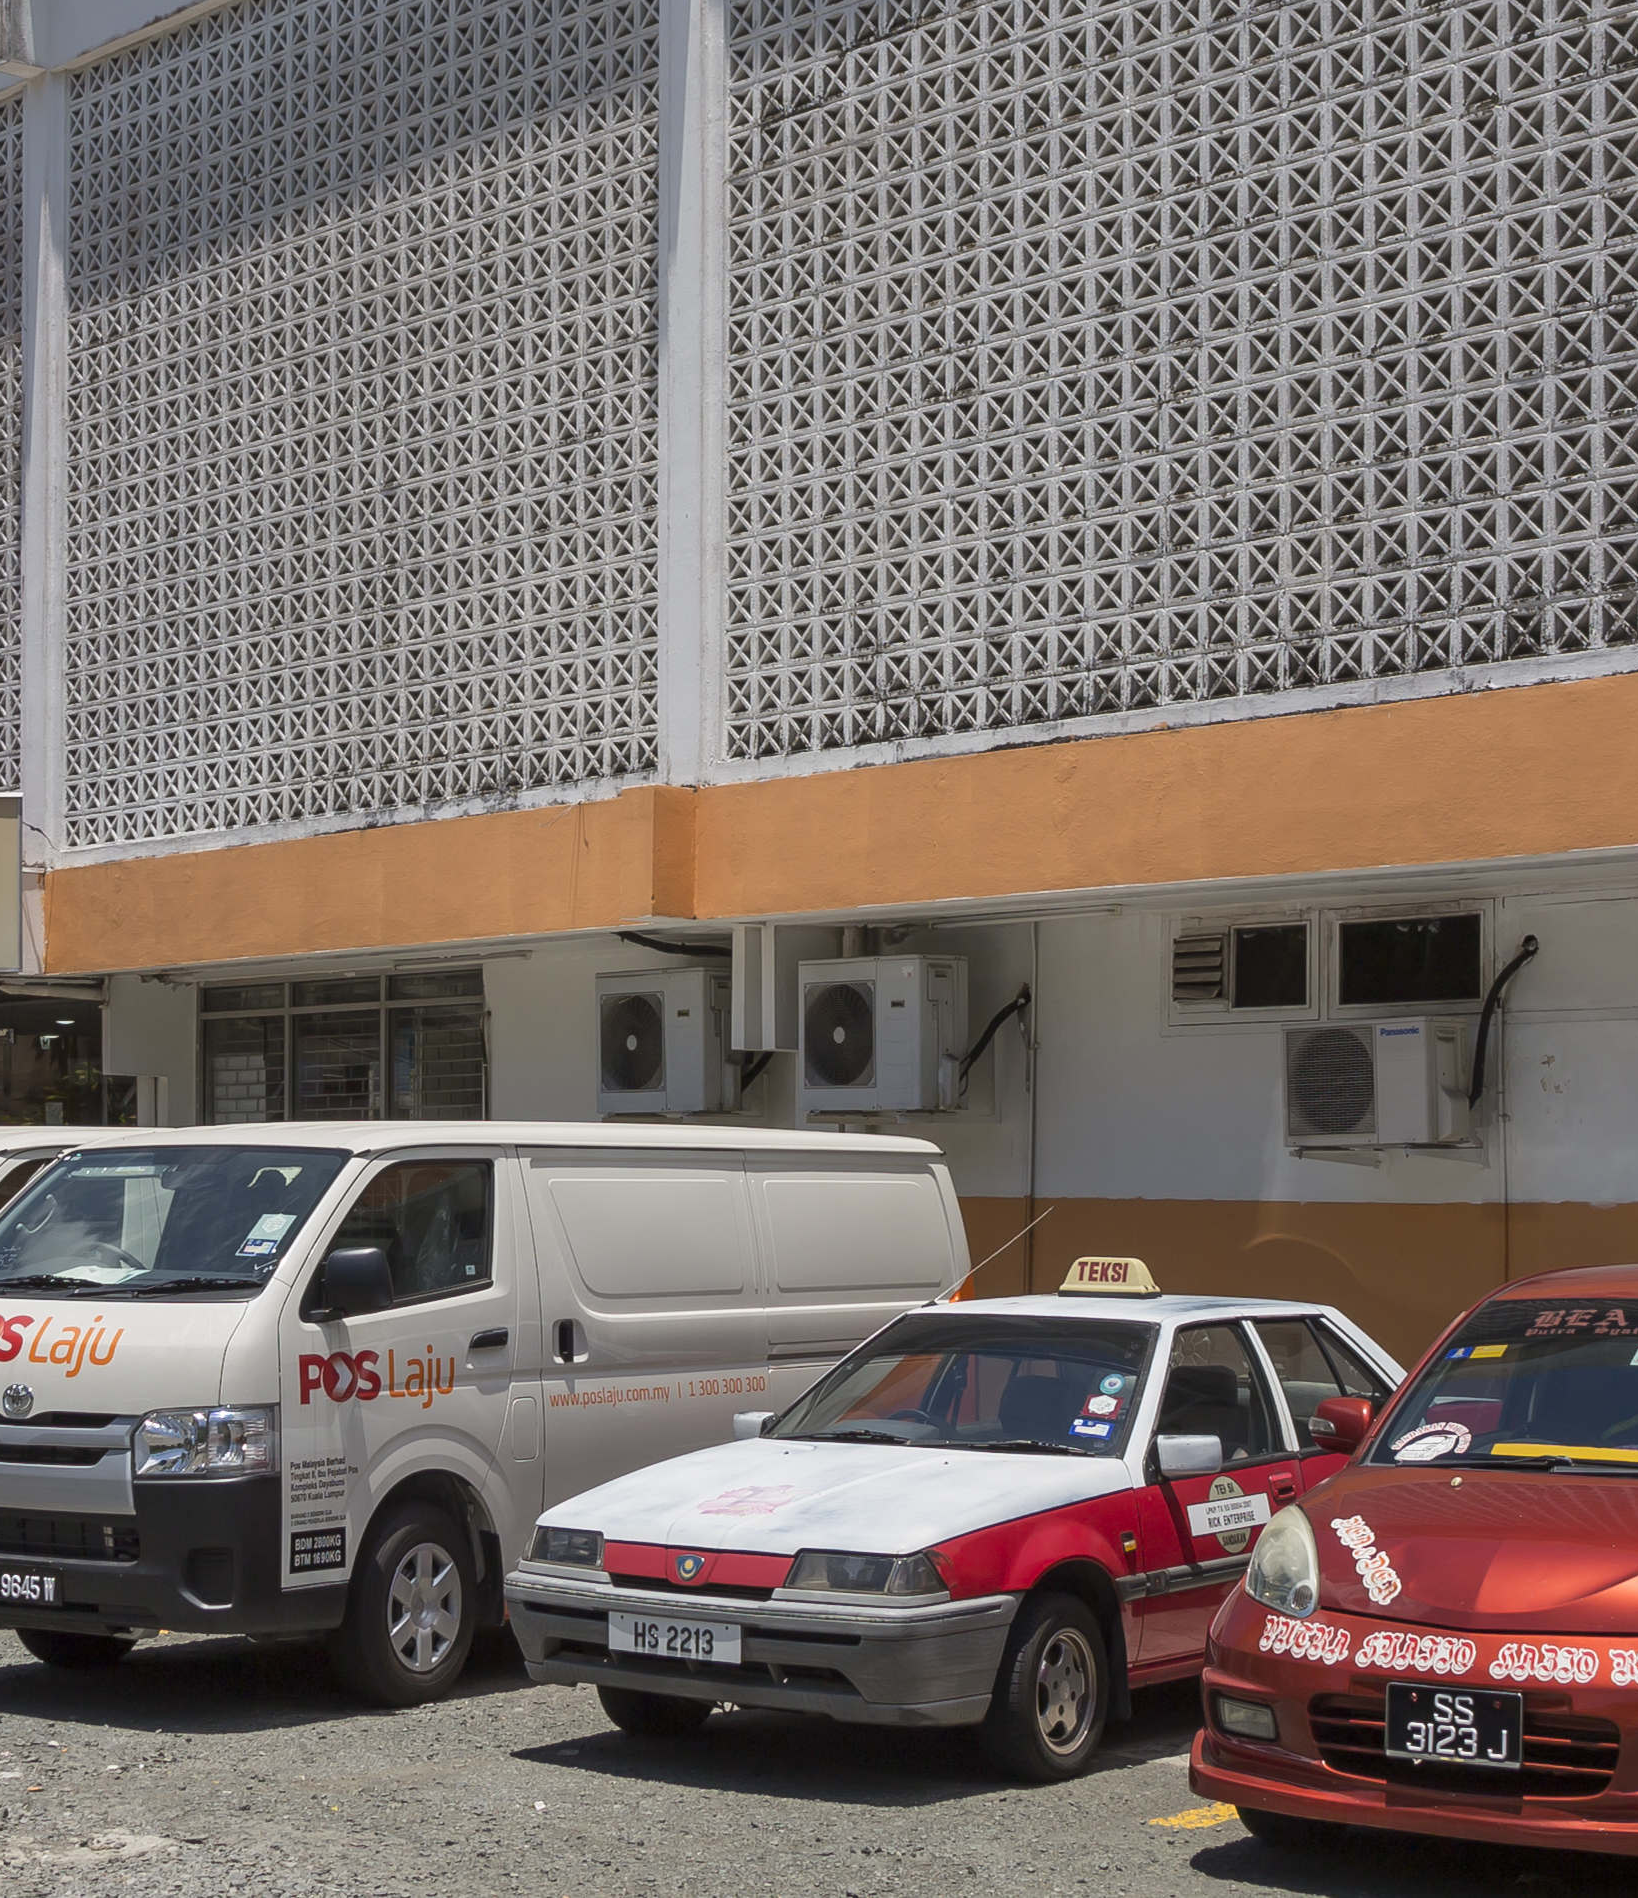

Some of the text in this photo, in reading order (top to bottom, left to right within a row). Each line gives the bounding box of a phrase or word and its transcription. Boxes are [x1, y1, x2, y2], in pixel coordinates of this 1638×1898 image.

[1379, 1026, 1420, 1037] Panasonic
[1077, 1261, 1129, 1283] TEKSI
[28, 1314, 125, 1378] Laju
[299, 1343, 455, 1410] POS Laju
[549, 1375, 766, 1409] www.poslaju.com.my 1 300 300 300
[290, 1456, 346, 1470] Pos Malaysia Berhad
[290, 1471, 311, 1482] Tingkat
[348, 1465, 359, 1475] Pos
[290, 1478, 346, 1493] Kompleks Dayabumi
[307, 1491, 324, 1501] Kuala
[324, 1489, 346, 1500] Lumpur
[1207, 1510, 1256, 1529] RICK ENTERPRISE
[294, 1534, 342, 1551] BDM 2800KG
[1222, 1532, 1248, 1548] SANDAKAN
[294, 1553, 312, 1567] BTM
[1, 1573, 40, 1601] 9645
[43, 1576, 56, 1602] W
[633, 1621, 715, 1655] HS 2213
[1433, 1693, 1474, 1725] SS
[1406, 1722, 1509, 1761] 3123 J
